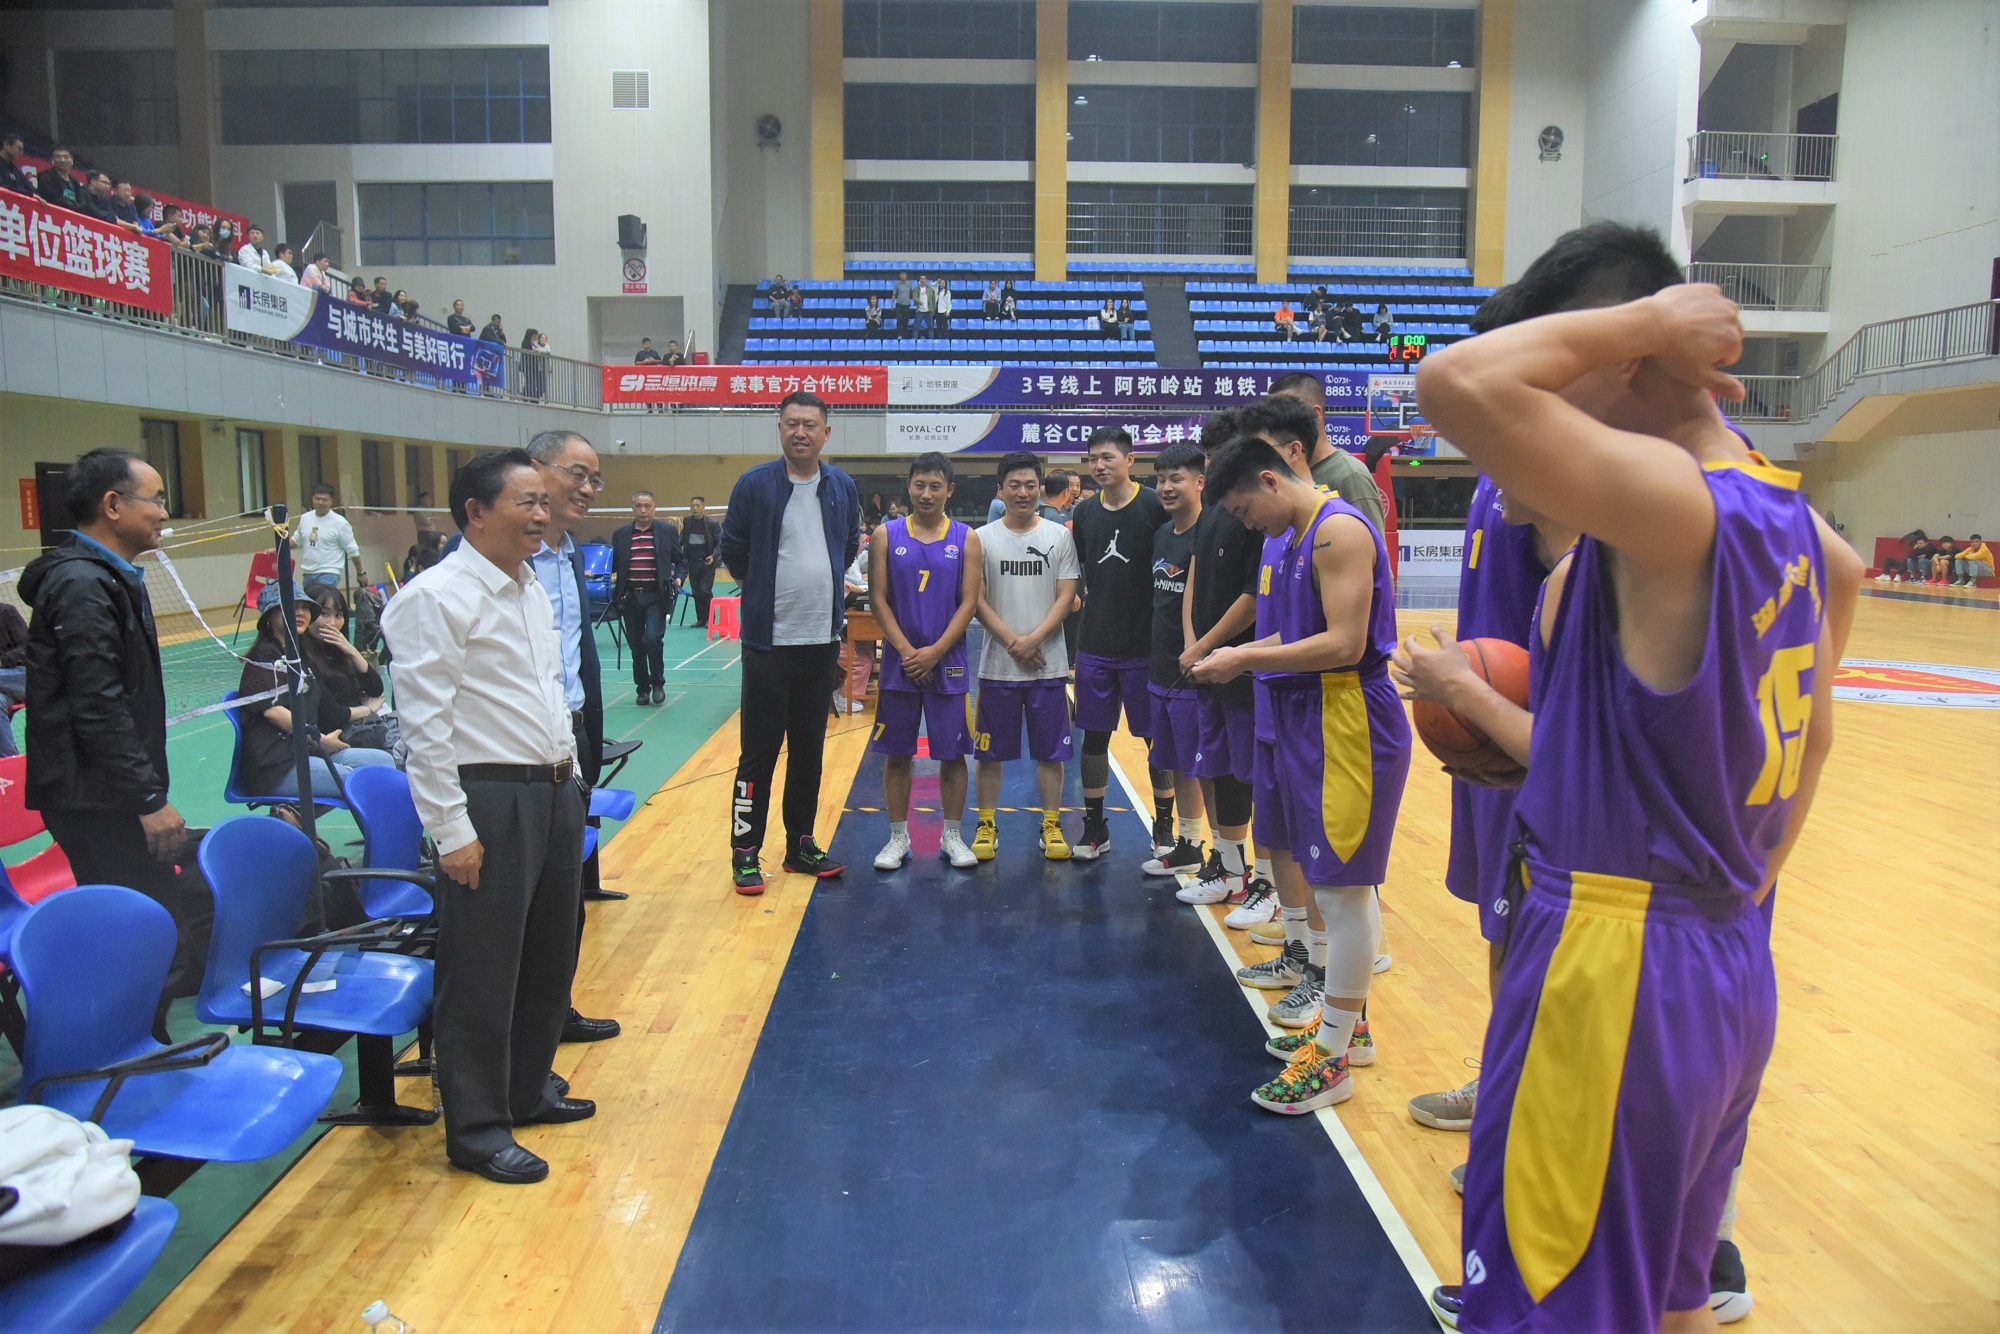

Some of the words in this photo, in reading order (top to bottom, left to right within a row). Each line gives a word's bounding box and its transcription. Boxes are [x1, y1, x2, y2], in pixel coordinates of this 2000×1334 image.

[0, 199, 150, 294] 单位篮球赛
[252, 289, 288, 313] 长房集团
[327, 304, 399, 354] 与城市共生
[401, 327, 465, 371] 与美好同行
[1404, 335, 1425, 346] 10:00
[1402, 344, 1420, 359] 24
[644, 374, 718, 388] 三恒体育
[730, 375, 872, 394] 赛事官方合作伙伴
[926, 380, 958, 389] 地铁银座
[1021, 376, 1102, 395] 3号线上
[1114, 375, 1203, 396] 阿弥岭站
[1325, 386, 1352, 397] 8883
[1021, 423, 1105, 444] 麓谷CB
[1413, 546, 1464, 557] 长房集团
[1468, 529, 1483, 569] 1
[1000, 560, 1043, 576] PUMA
[918, 569, 930, 592] 7
[1153, 577, 1185, 593] I-NING
[873, 722, 886, 742] 7
[1746, 643, 1816, 806] 15
[974, 731, 991, 752] 26
[733, 780, 754, 837] FILA
